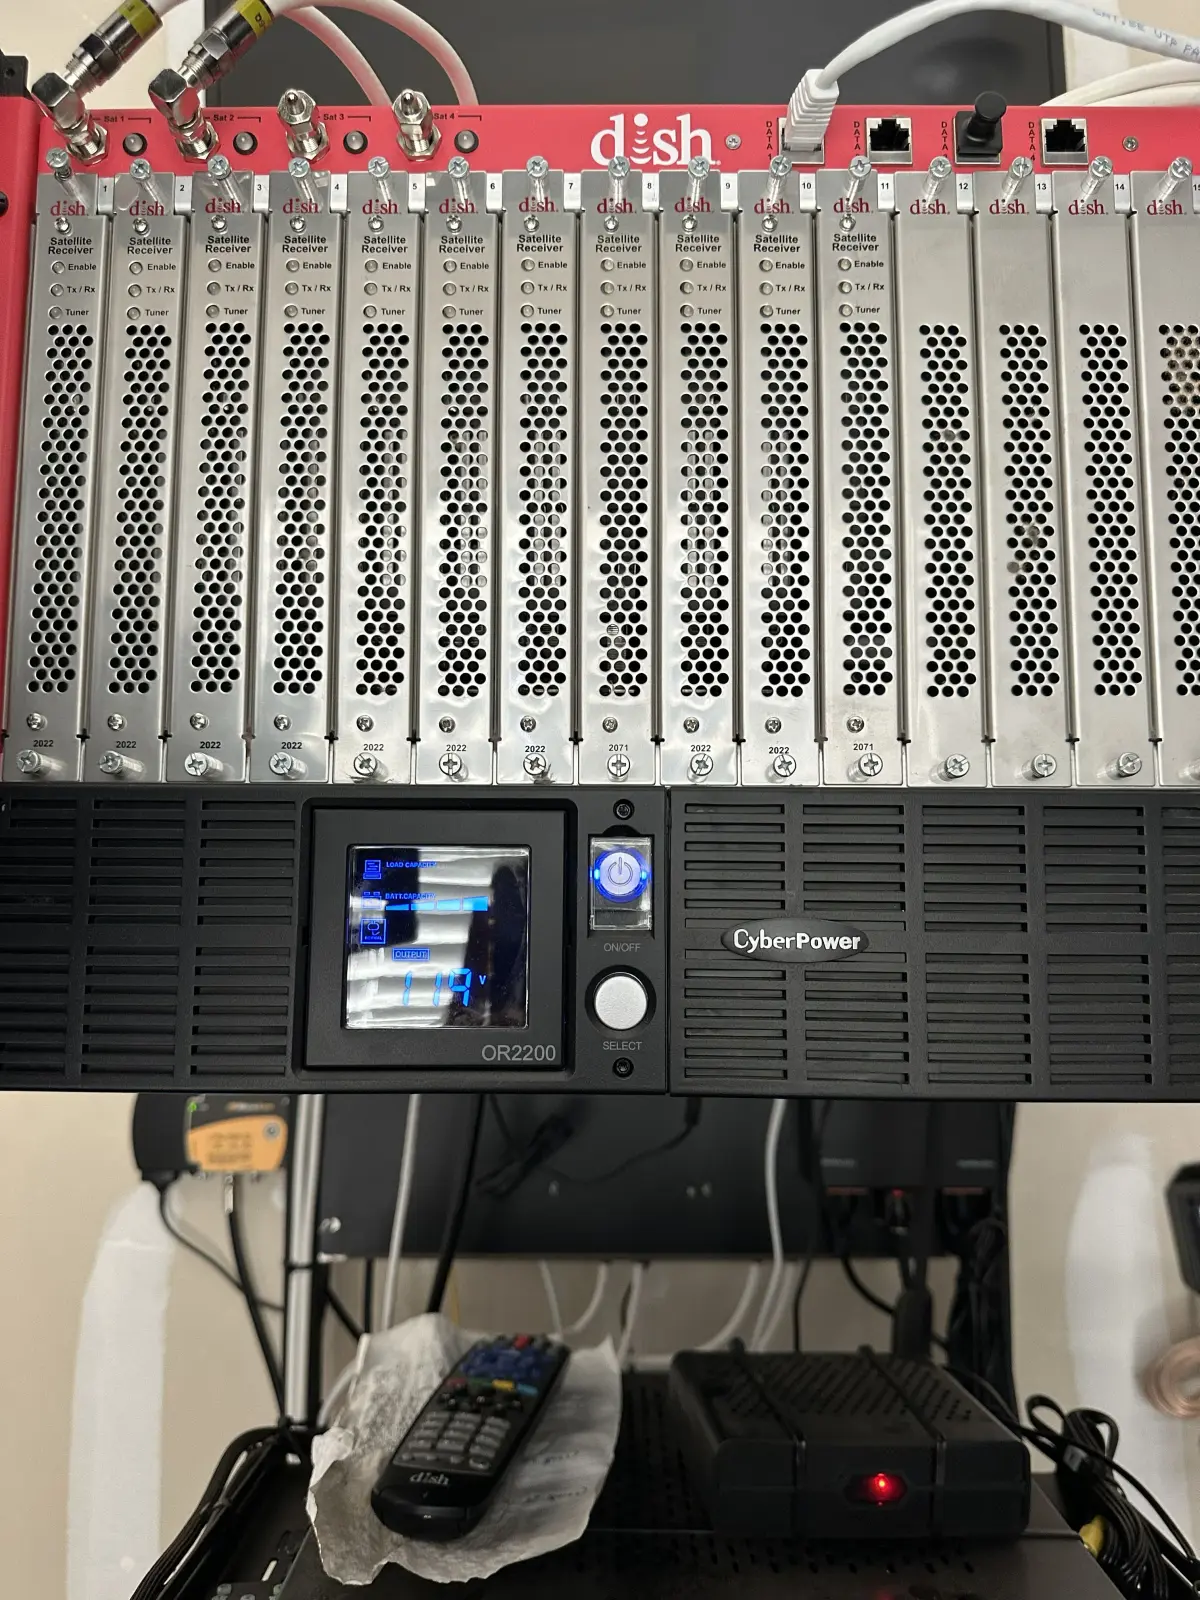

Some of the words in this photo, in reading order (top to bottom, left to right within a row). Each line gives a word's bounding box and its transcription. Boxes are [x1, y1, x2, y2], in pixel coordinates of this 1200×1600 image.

[1154, 28, 1178, 47] UTP
[591, 113, 716, 165] dish
[941, 121, 949, 150] DATA
[50, 201, 86, 216] dish
[129, 200, 165, 216] dish
[205, 198, 241, 213] dish
[283, 198, 319, 214] dish
[362, 199, 399, 214] dish
[439, 198, 476, 214] dish
[519, 197, 556, 213] dish
[597, 198, 633, 214] dish
[674, 198, 711, 213] dish
[754, 198, 791, 214] dish
[833, 198, 870, 214] dish
[910, 200, 946, 214] dish
[989, 199, 1025, 214] dish
[1069, 200, 1104, 214] dish
[1147, 200, 1183, 215] dish
[50, 237, 92, 246] Satellite
[129, 237, 171, 246] Satellite
[207, 235, 249, 244] Satellite
[284, 235, 326, 244] Satellite
[364, 236, 406, 244] Satellite
[441, 236, 483, 244] Satellite
[519, 235, 562, 243] Satellite
[597, 235, 640, 243] Satellite
[677, 235, 719, 243] Satellite
[755, 235, 798, 243] Satellite
[834, 234, 876, 242] Satellite
[48, 246, 93, 255] Receiver
[127, 246, 173, 255] Receiver
[205, 244, 251, 253] Receiver
[282, 244, 328, 253] Receiver
[361, 245, 408, 253] Receiver
[439, 245, 485, 253] Receiver
[516, 244, 563, 252] Receiver
[595, 244, 642, 253] Receiver
[675, 244, 721, 252] Receiver
[753, 244, 800, 252] Receiver
[832, 243, 879, 251] Receiver
[116, 741, 137, 749] 2022
[200, 741, 221, 749] 2022
[446, 744, 467, 752] 2022
[525, 745, 546, 753] 2022
[609, 744, 629, 752] 2071
[690, 744, 711, 752] 2022
[853, 743, 874, 751] 2071
[769, 746, 789, 754] 2022
[734, 928, 861, 953] CyberPower
[604, 943, 640, 952] ON/OFF
[394, 950, 426, 958] OUTPUT
[402, 968, 472, 1007] 119
[479, 975, 487, 985] V
[603, 1042, 642, 1050] SELECT
[482, 1045, 556, 1061] OR2200
[409, 1471, 449, 1486] dish
